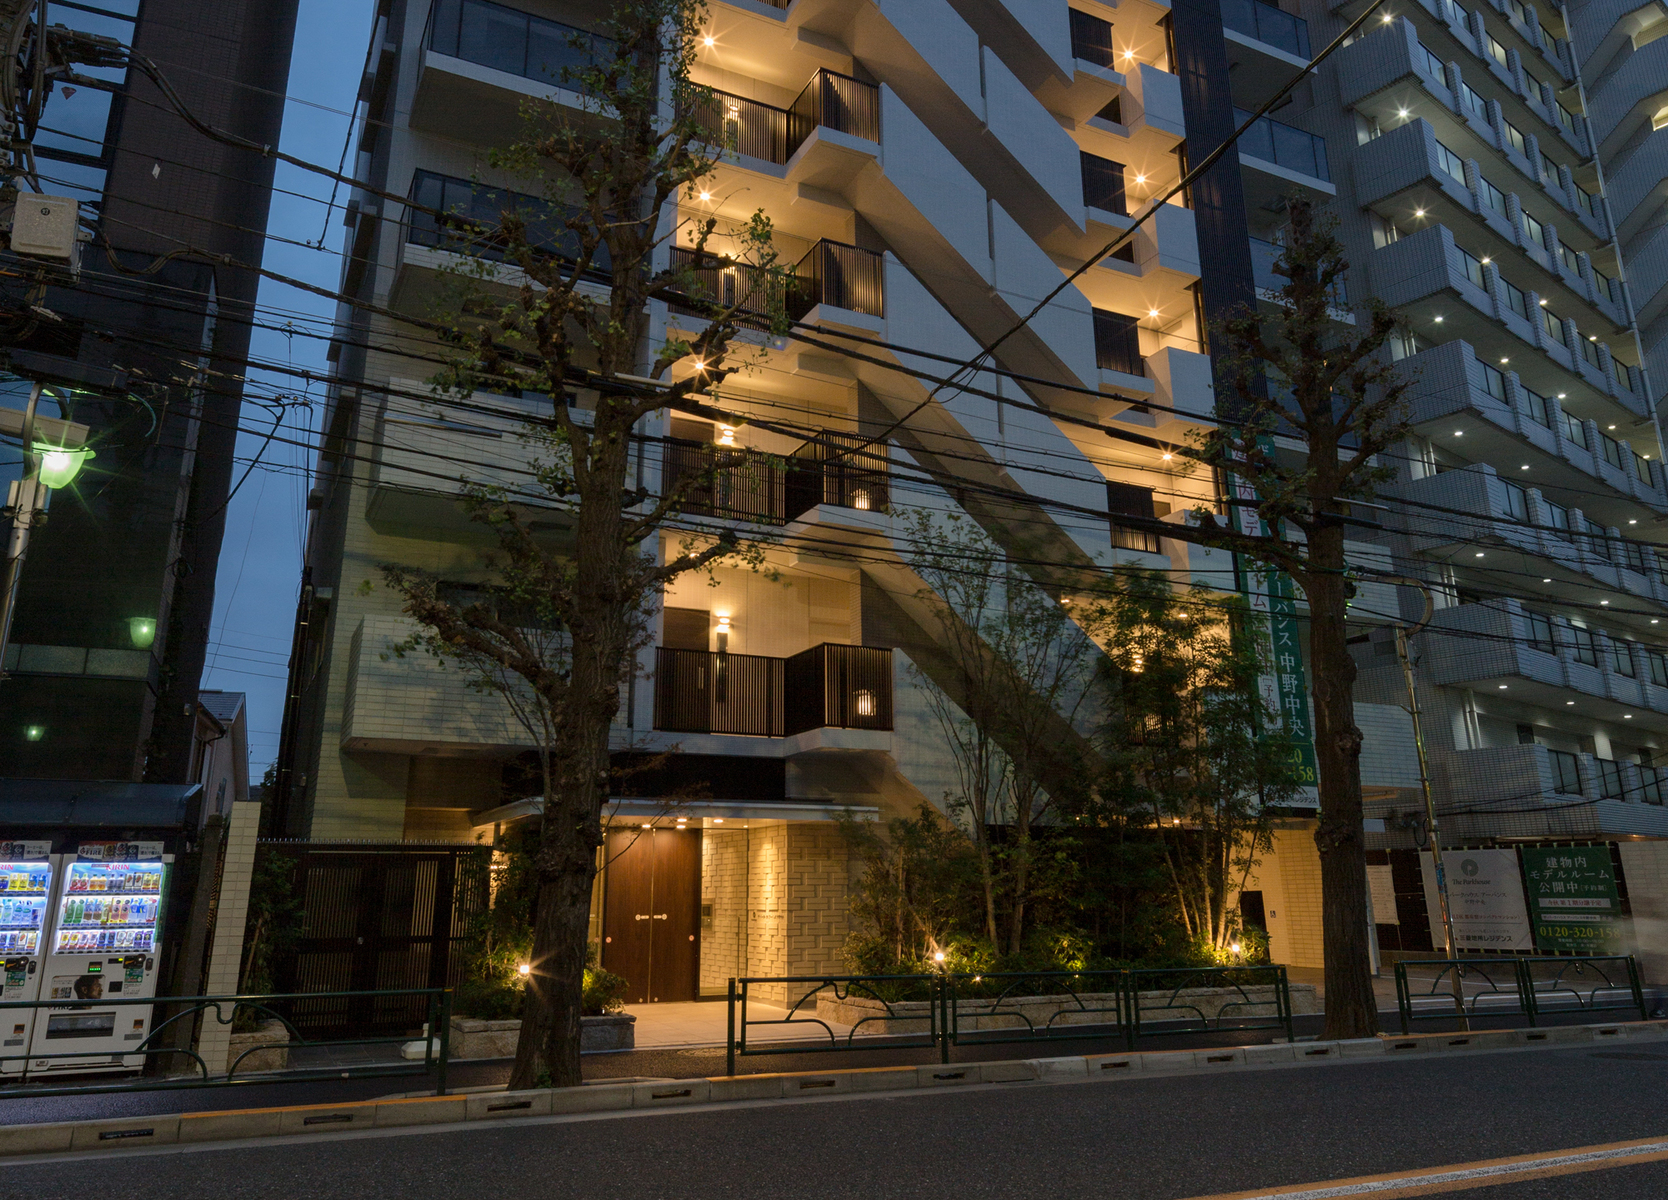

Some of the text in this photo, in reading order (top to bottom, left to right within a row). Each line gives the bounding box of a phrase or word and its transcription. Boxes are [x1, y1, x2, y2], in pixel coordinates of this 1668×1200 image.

[1280, 652, 1305, 737] 中野中央
[1546, 856, 1587, 868] 建物内
[1530, 869, 1609, 880] モデルルーム
[1463, 878, 1491, 886] Parkhouse
[1539, 881, 1578, 894] 公開中
[1540, 926, 1621, 938] 0120-320-158
